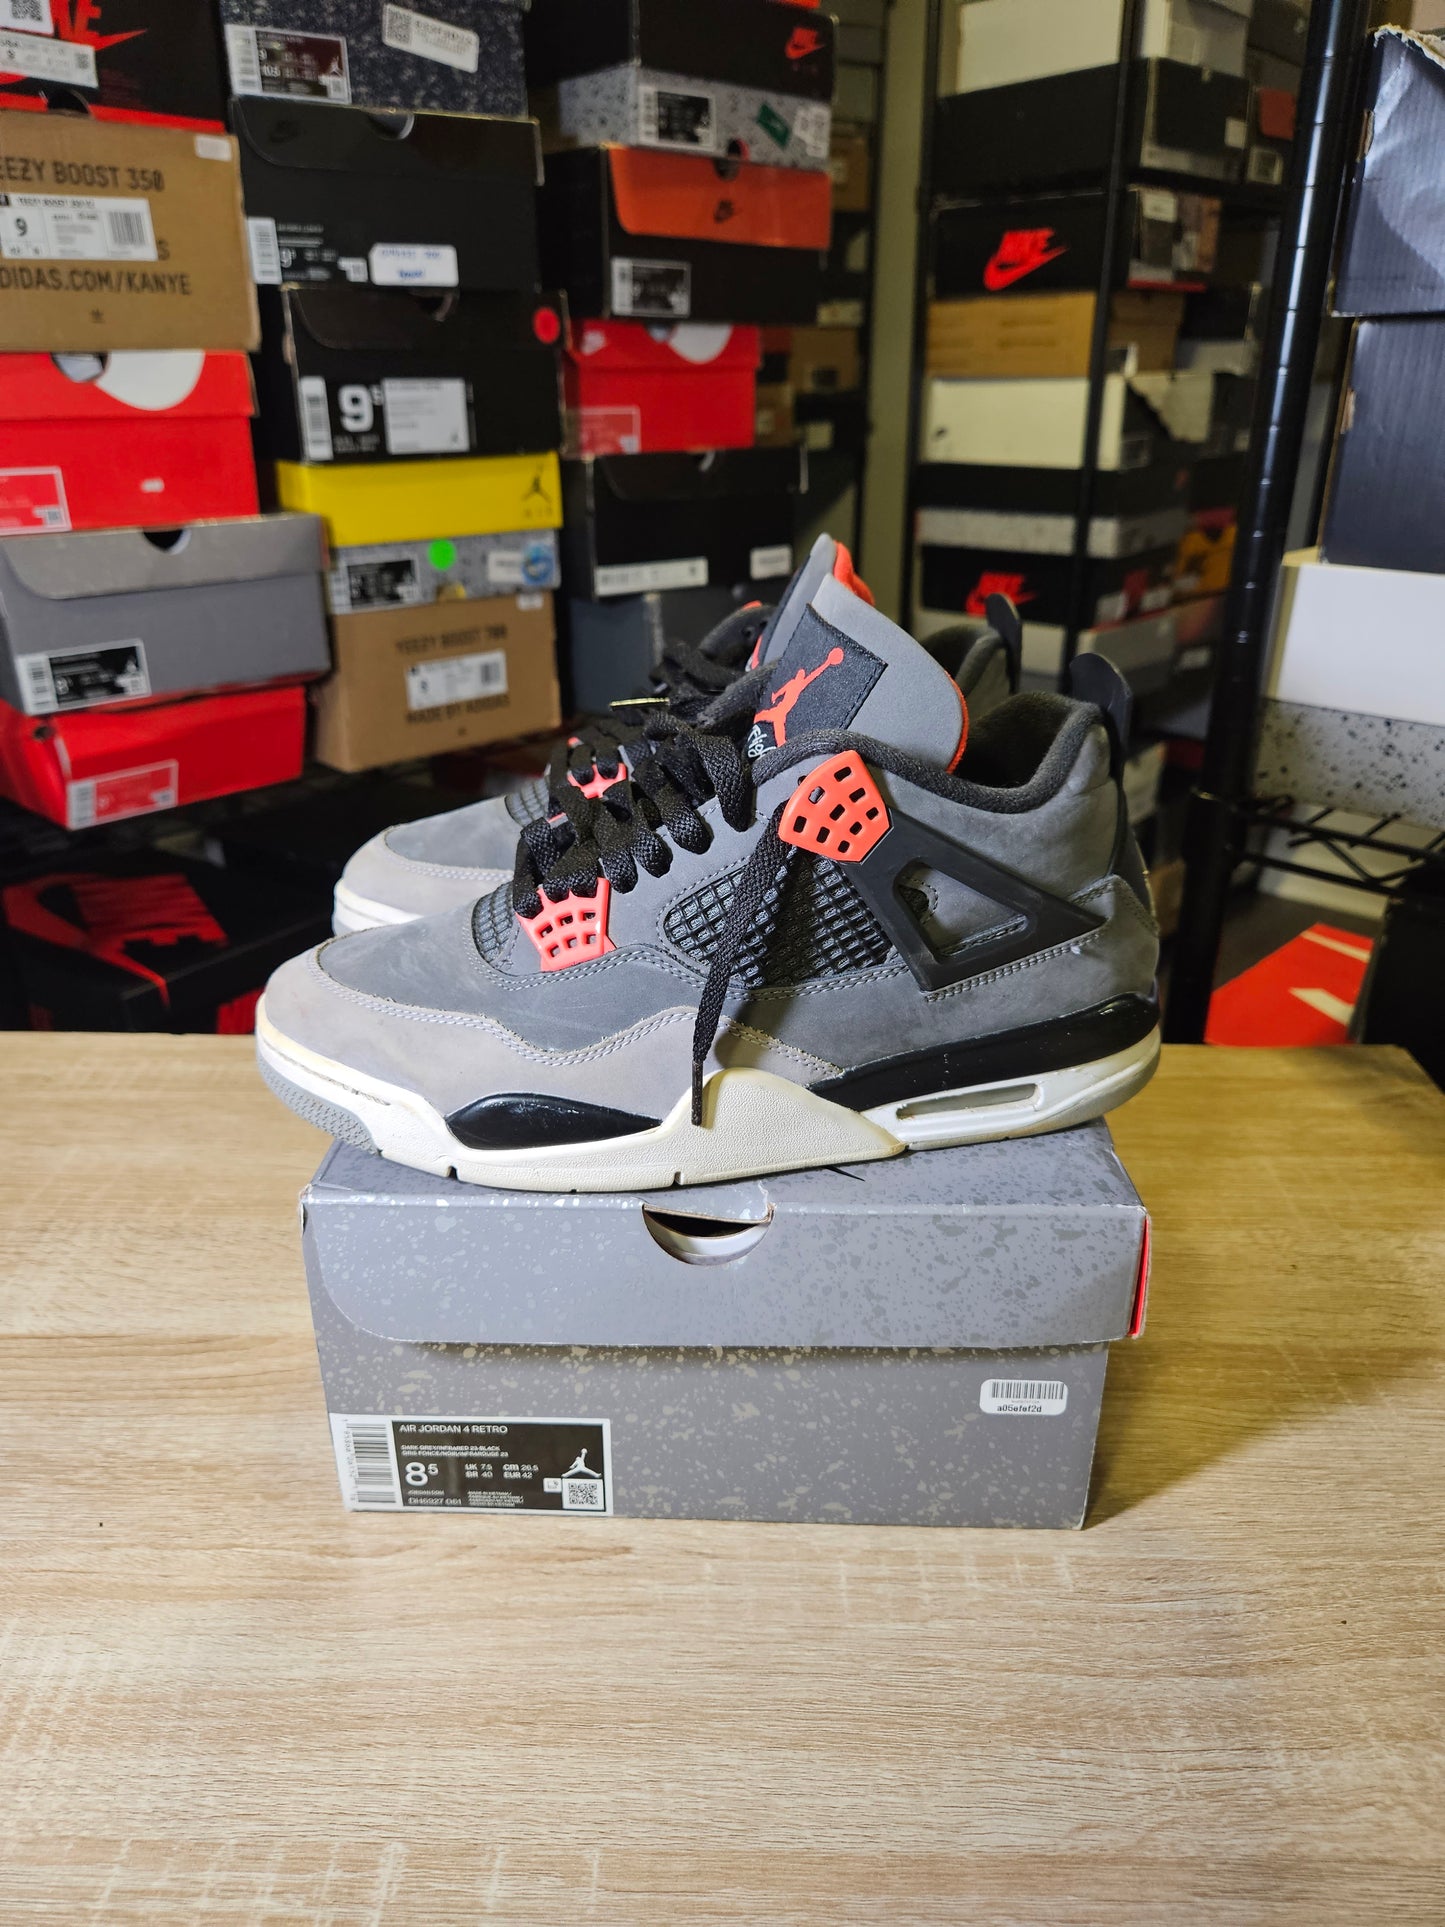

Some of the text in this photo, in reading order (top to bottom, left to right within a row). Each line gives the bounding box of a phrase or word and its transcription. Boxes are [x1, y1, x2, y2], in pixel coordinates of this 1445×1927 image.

[52, 161, 119, 188] BOOST
[127, 168, 165, 191] 350
[399, 1424, 508, 1435] AIR JORDAN 4 RETRO
[464, 1463, 478, 1471] UK
[465, 1470, 493, 1478] BR 40
[503, 1470, 533, 1479] EUR 42
